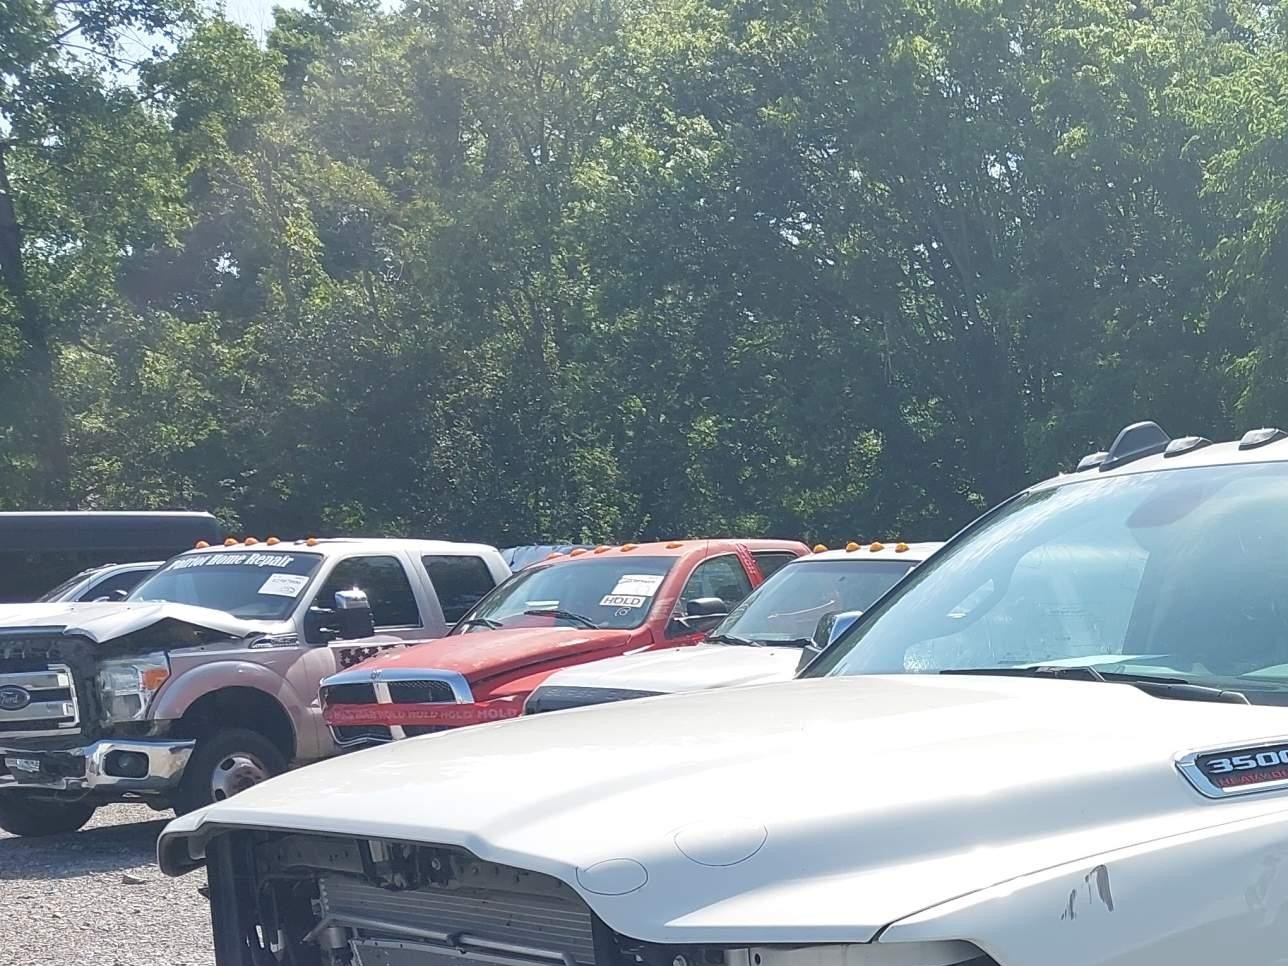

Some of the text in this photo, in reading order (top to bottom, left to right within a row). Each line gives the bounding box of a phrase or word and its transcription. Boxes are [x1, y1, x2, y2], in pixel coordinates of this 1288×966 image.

[206, 554, 247, 566] Home
[244, 553, 294, 568] Repair
[603, 596, 641, 606] HOLD
[477, 708, 518, 720] HOLD
[1217, 773, 1266, 787] HEAVY
